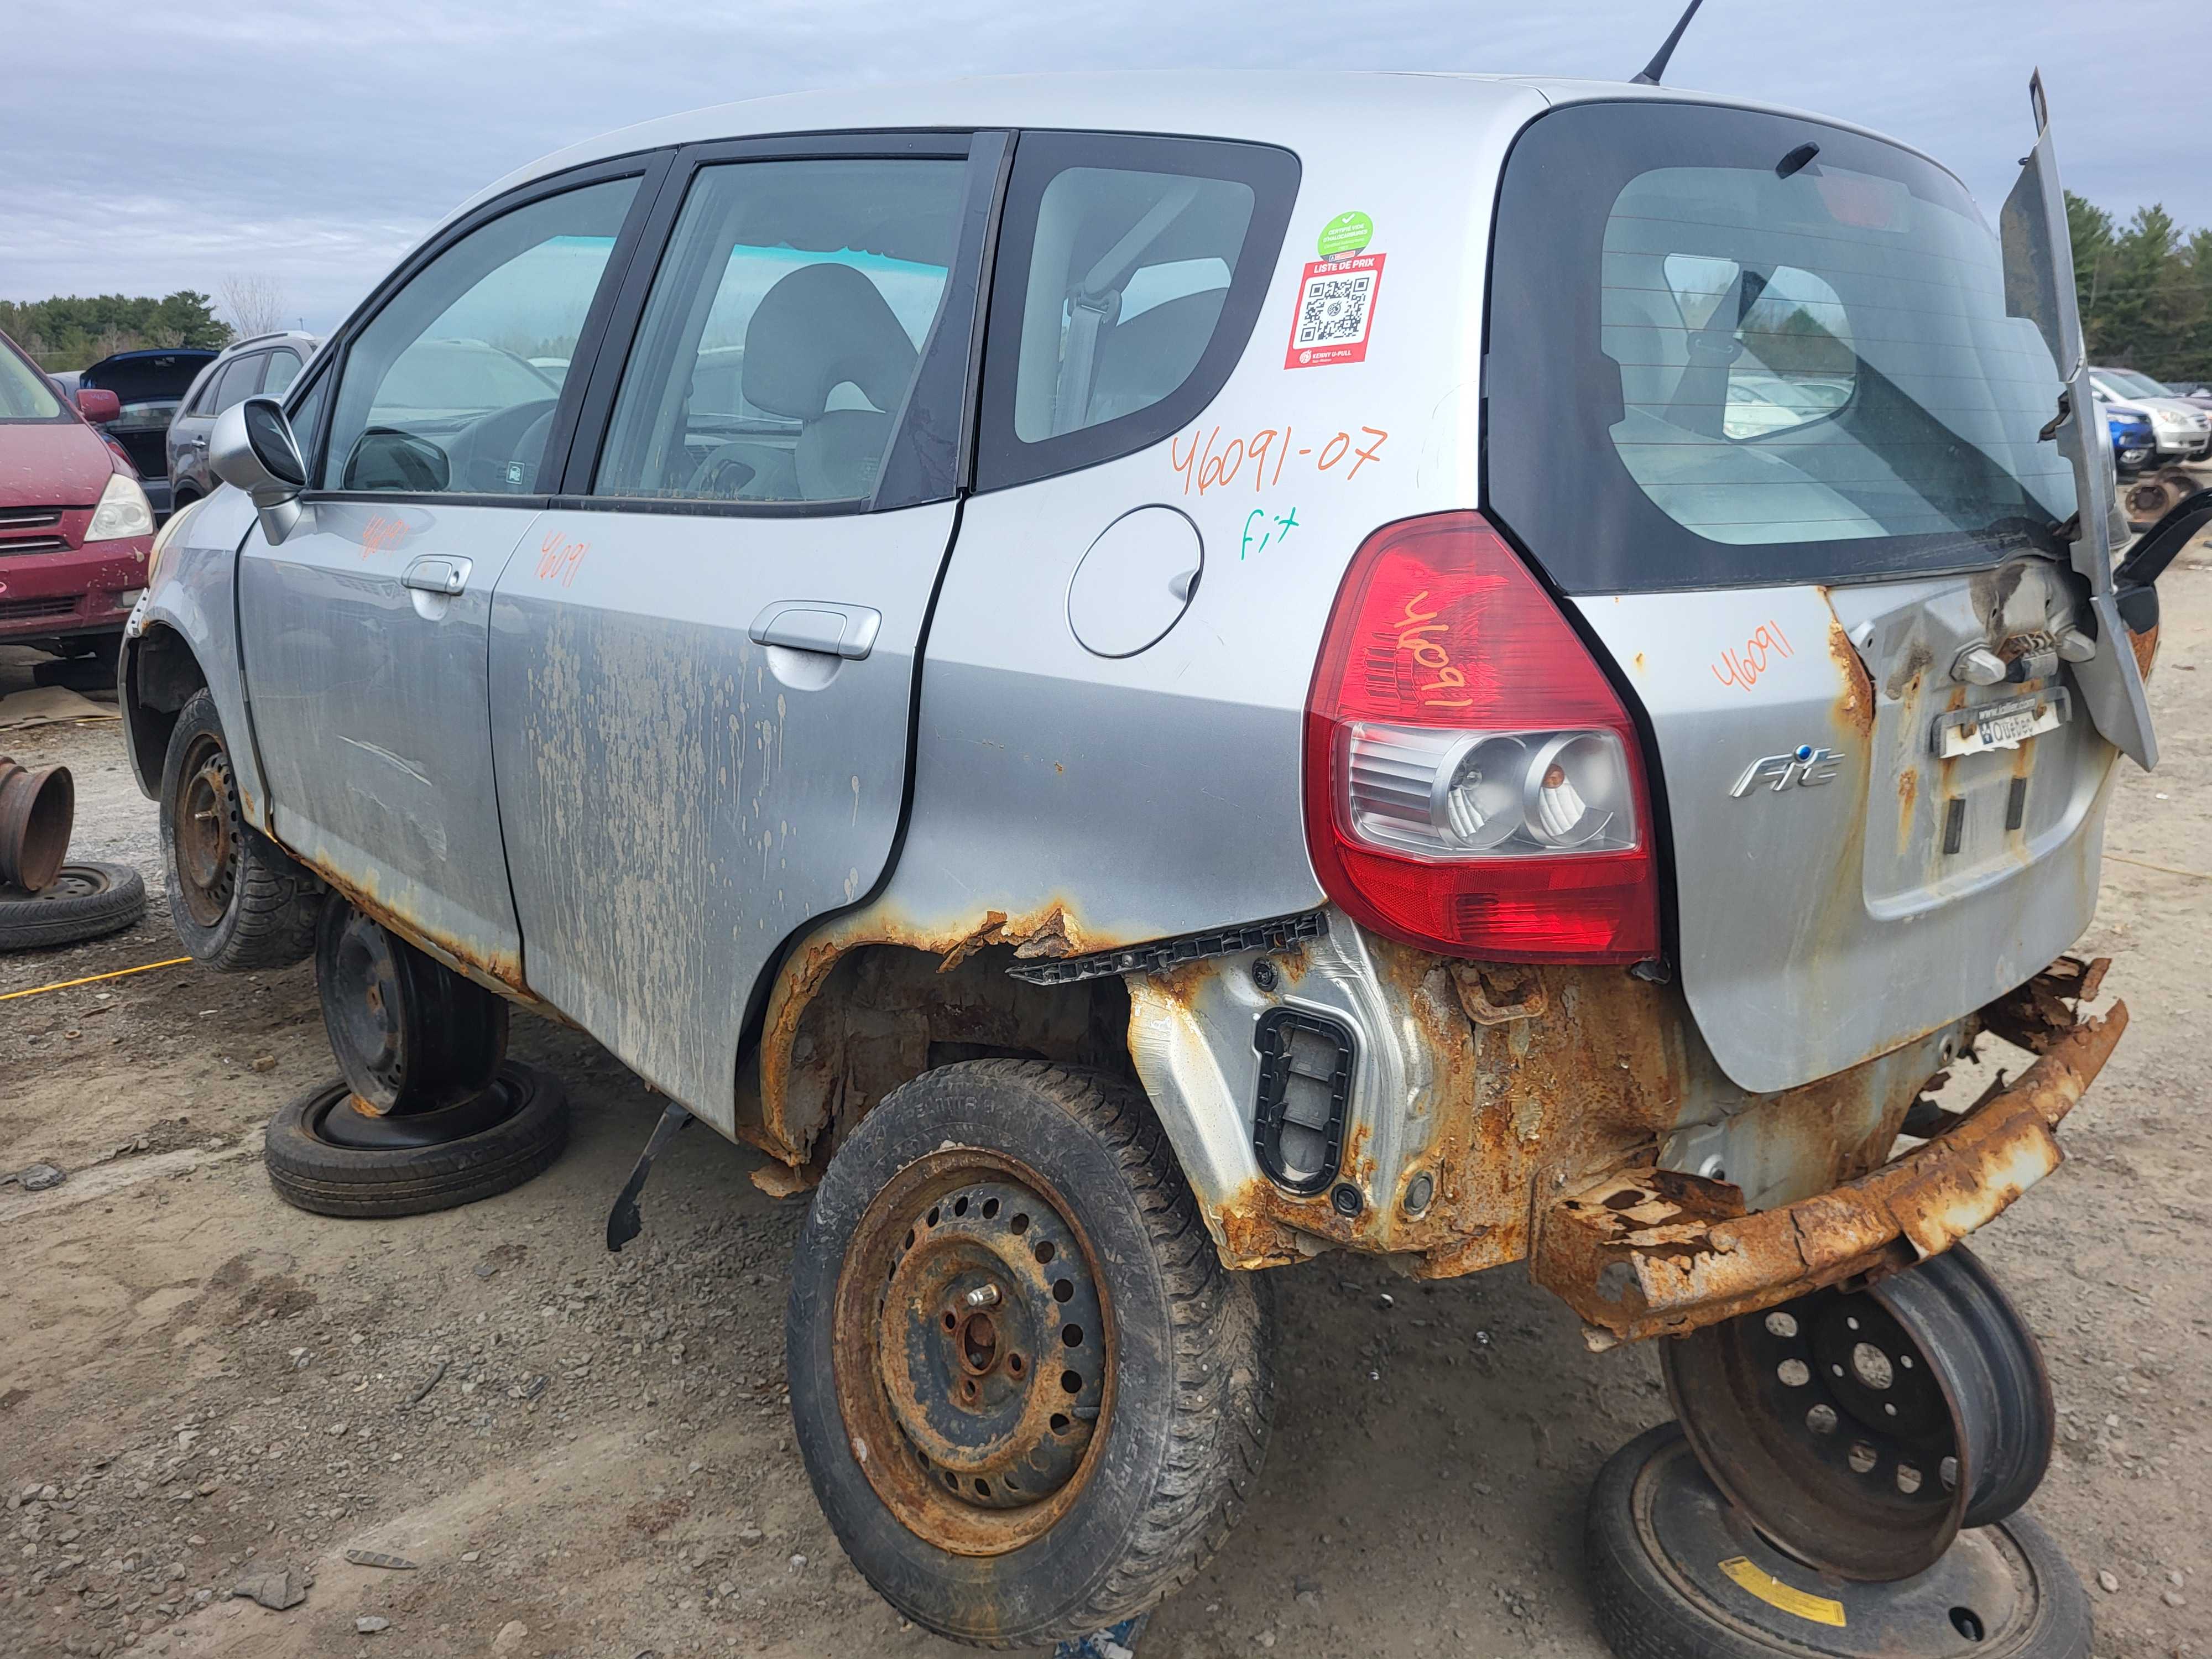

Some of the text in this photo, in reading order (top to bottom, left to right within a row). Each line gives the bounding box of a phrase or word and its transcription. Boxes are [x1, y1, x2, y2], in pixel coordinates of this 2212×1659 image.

[1314, 257, 1375, 274] LISTE DE PRIX
[1172, 426, 1388, 496] 46091-07
[1393, 591, 1473, 707] 46091
[1712, 619, 1794, 692] 46091
